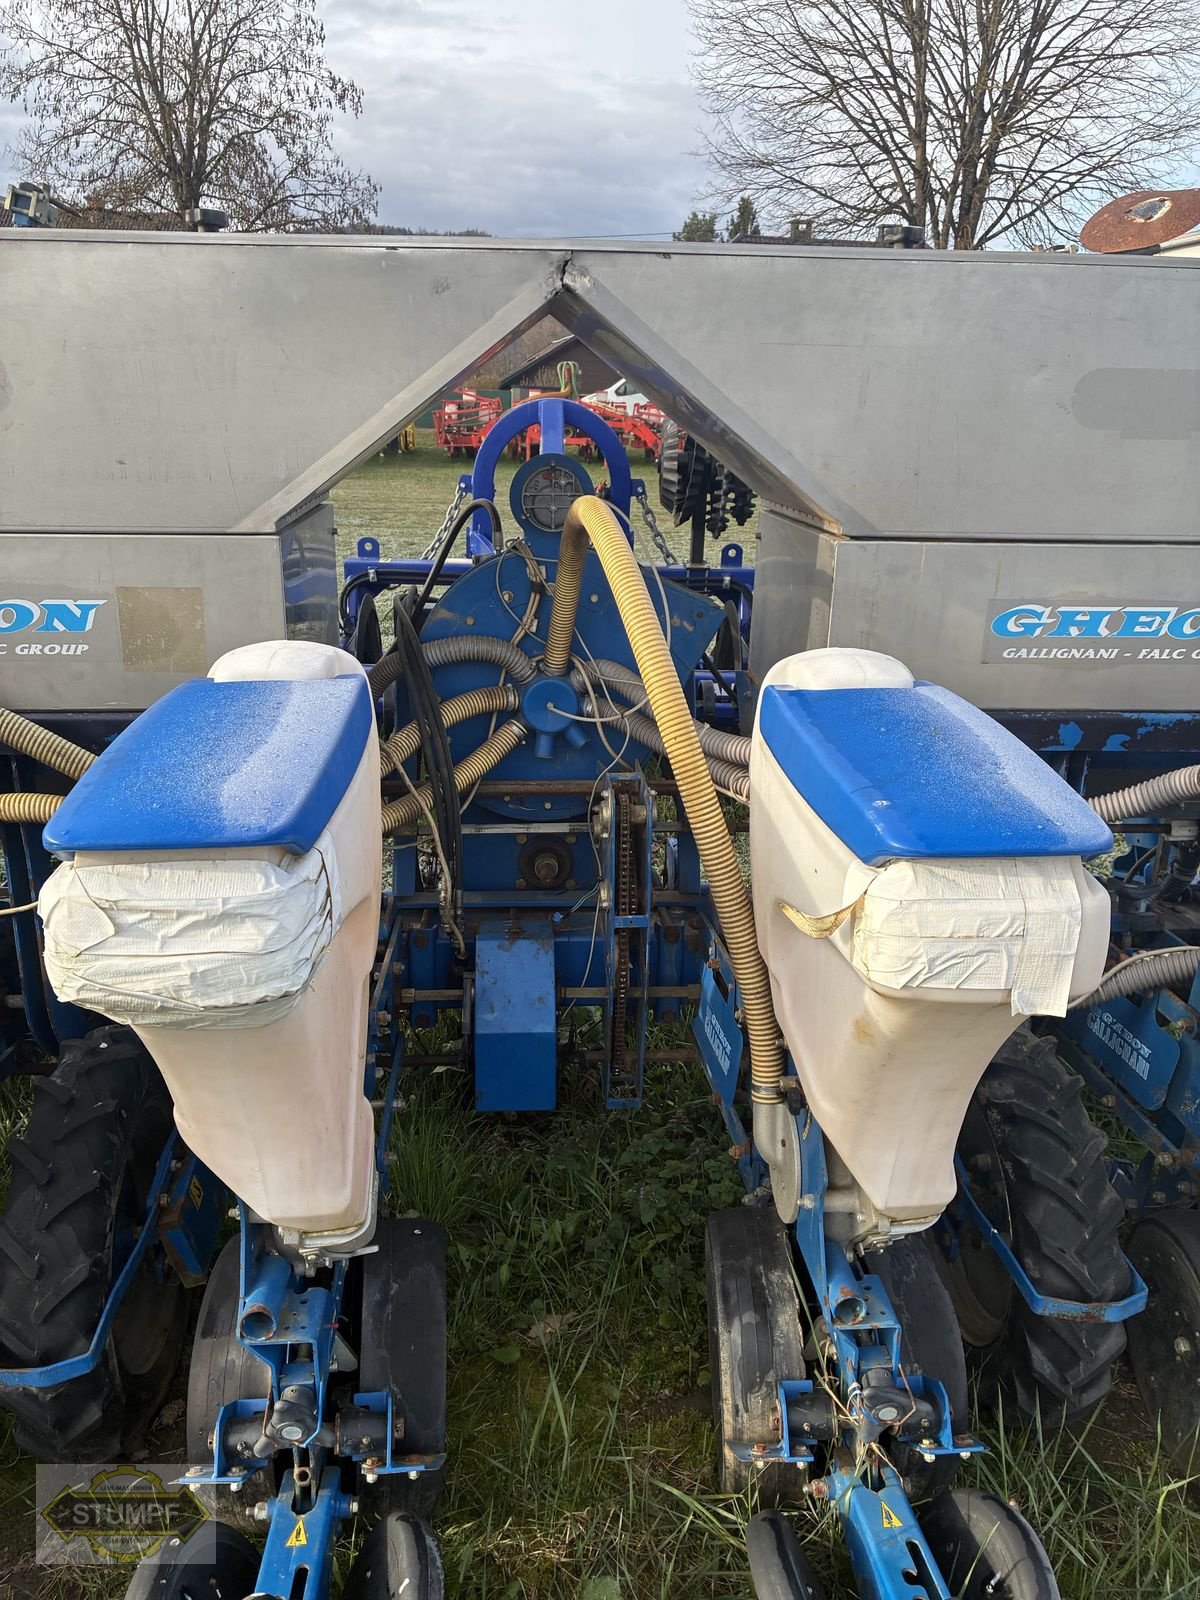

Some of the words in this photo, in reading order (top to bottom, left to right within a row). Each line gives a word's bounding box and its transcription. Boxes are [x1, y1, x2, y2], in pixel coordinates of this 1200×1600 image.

[15, 644, 90, 655] GROUP
[1002, 647, 1120, 659] GALLIGNANI
[1137, 648, 1186, 659] FALC
